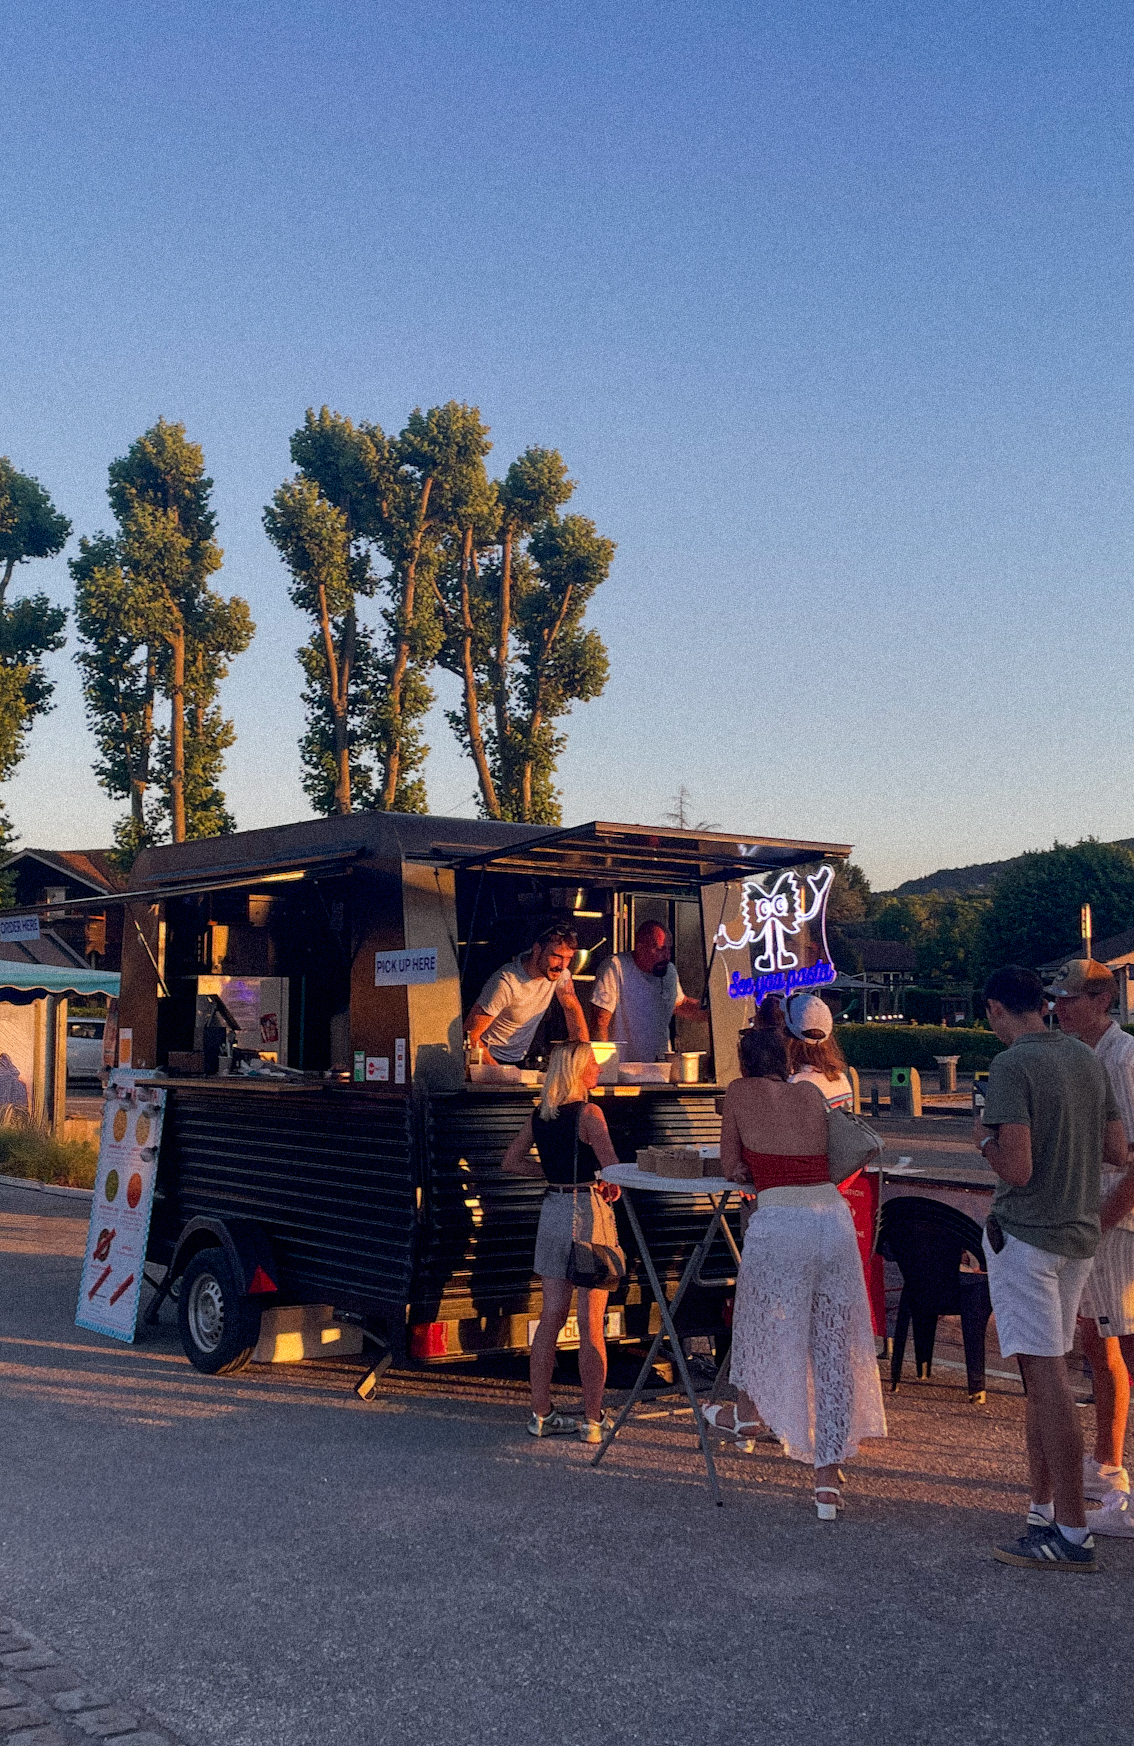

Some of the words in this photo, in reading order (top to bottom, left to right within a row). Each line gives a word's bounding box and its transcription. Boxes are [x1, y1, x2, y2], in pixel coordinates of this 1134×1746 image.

[22, 919, 38, 931] HERE
[376, 960, 396, 974] PICK
[398, 959, 411, 972] UP
[412, 956, 436, 971] HERE
